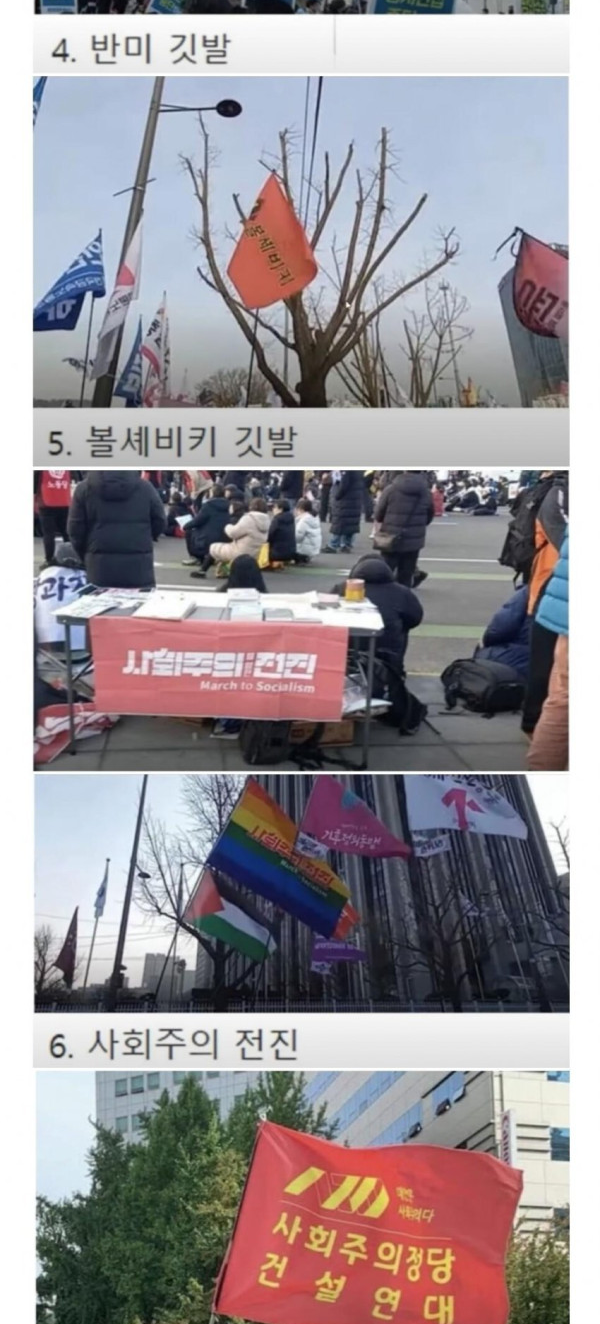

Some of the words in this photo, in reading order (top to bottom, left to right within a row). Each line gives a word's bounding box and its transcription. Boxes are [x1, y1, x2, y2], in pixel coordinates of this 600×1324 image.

[122, 647, 245, 678] 사회주의
[252, 651, 318, 681] 전진
[200, 680, 238, 691] March
[240, 681, 253, 691] to
[255, 681, 316, 694] Socialism
[272, 1211, 456, 1285] 사회주의정당
